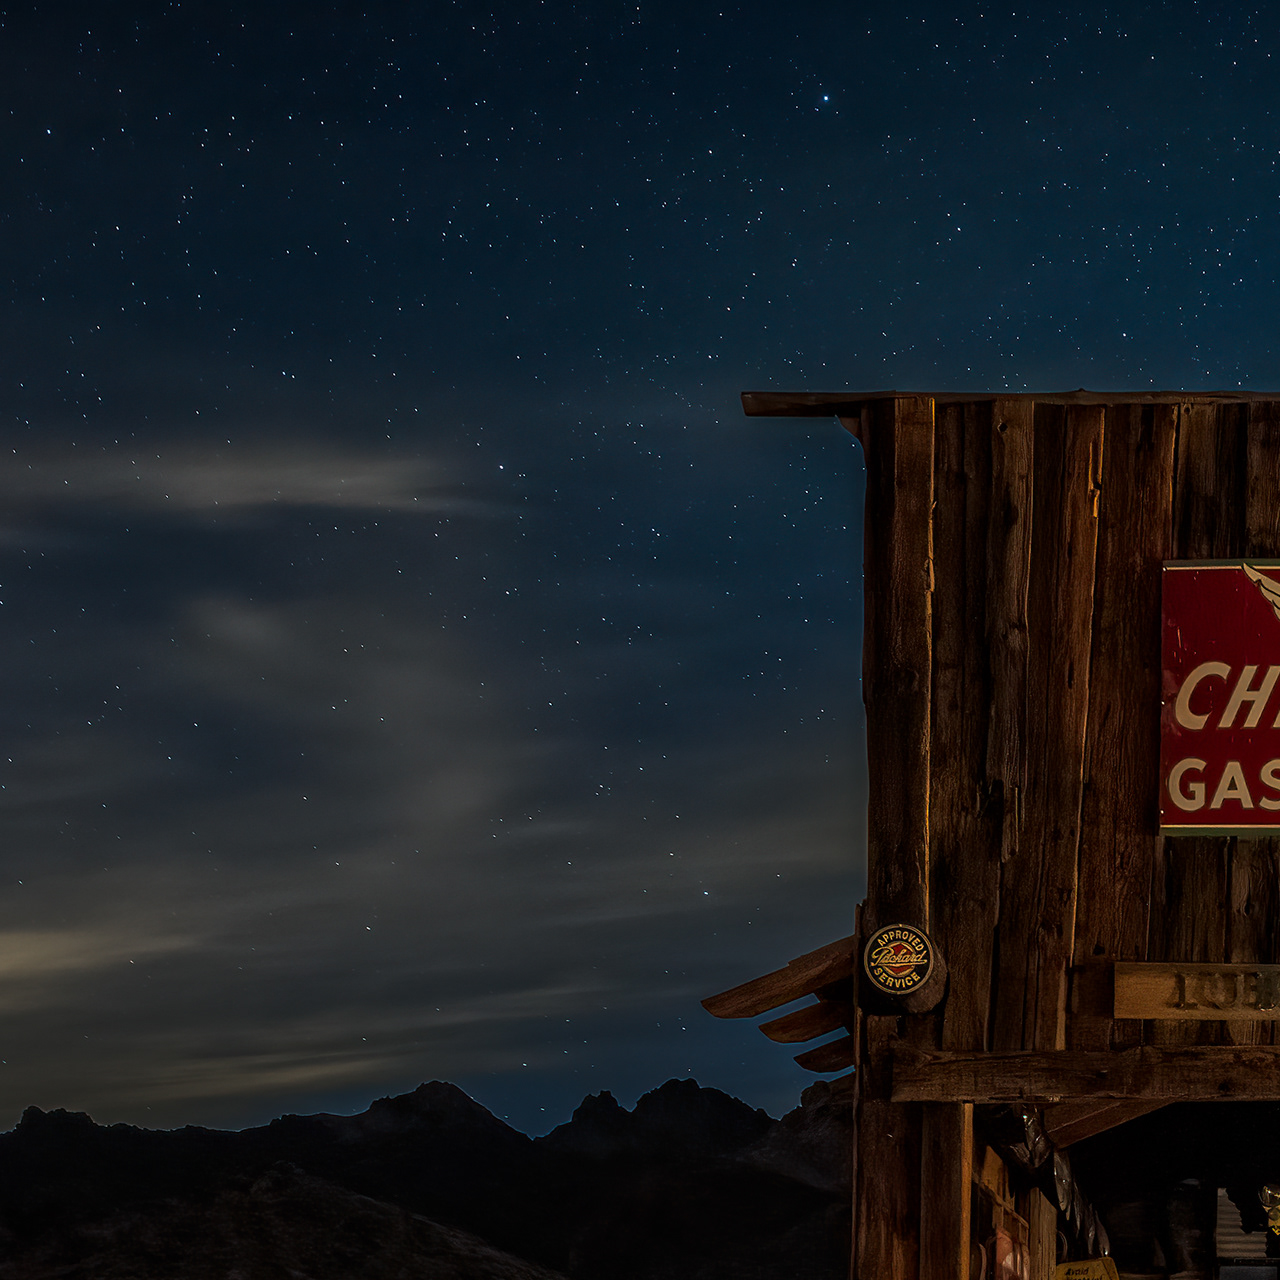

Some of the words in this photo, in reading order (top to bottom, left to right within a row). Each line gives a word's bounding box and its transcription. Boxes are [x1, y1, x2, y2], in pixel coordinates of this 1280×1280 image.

[877, 930, 924, 951] APPROVED
[871, 946, 927, 966] Packard
[874, 968, 920, 988] SERVICE
